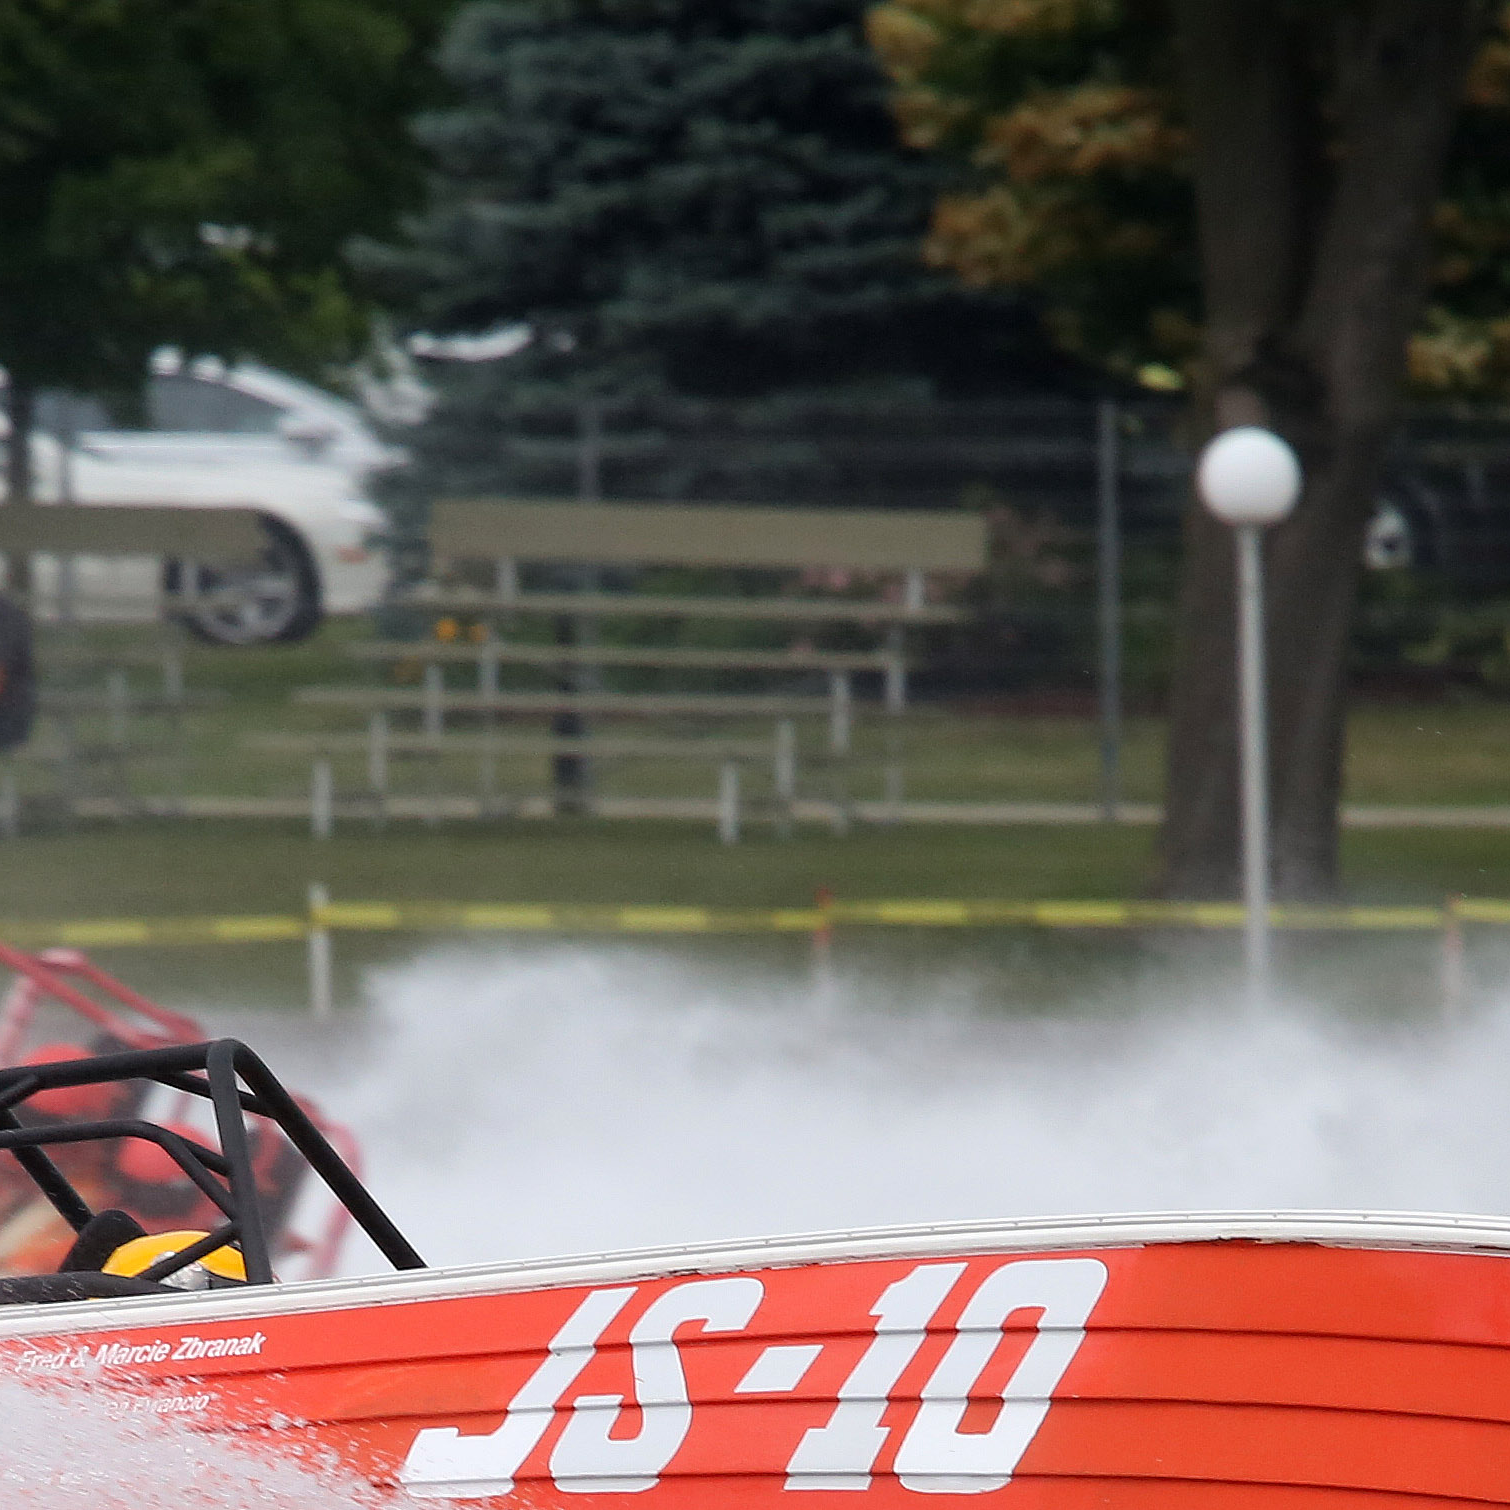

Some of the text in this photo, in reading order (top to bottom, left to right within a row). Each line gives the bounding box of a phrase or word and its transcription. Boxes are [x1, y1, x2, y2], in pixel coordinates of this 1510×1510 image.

[16, 1332, 267, 1371] Fred & Marcie Zbranak
[402, 1257, 1108, 1498] JS-10
